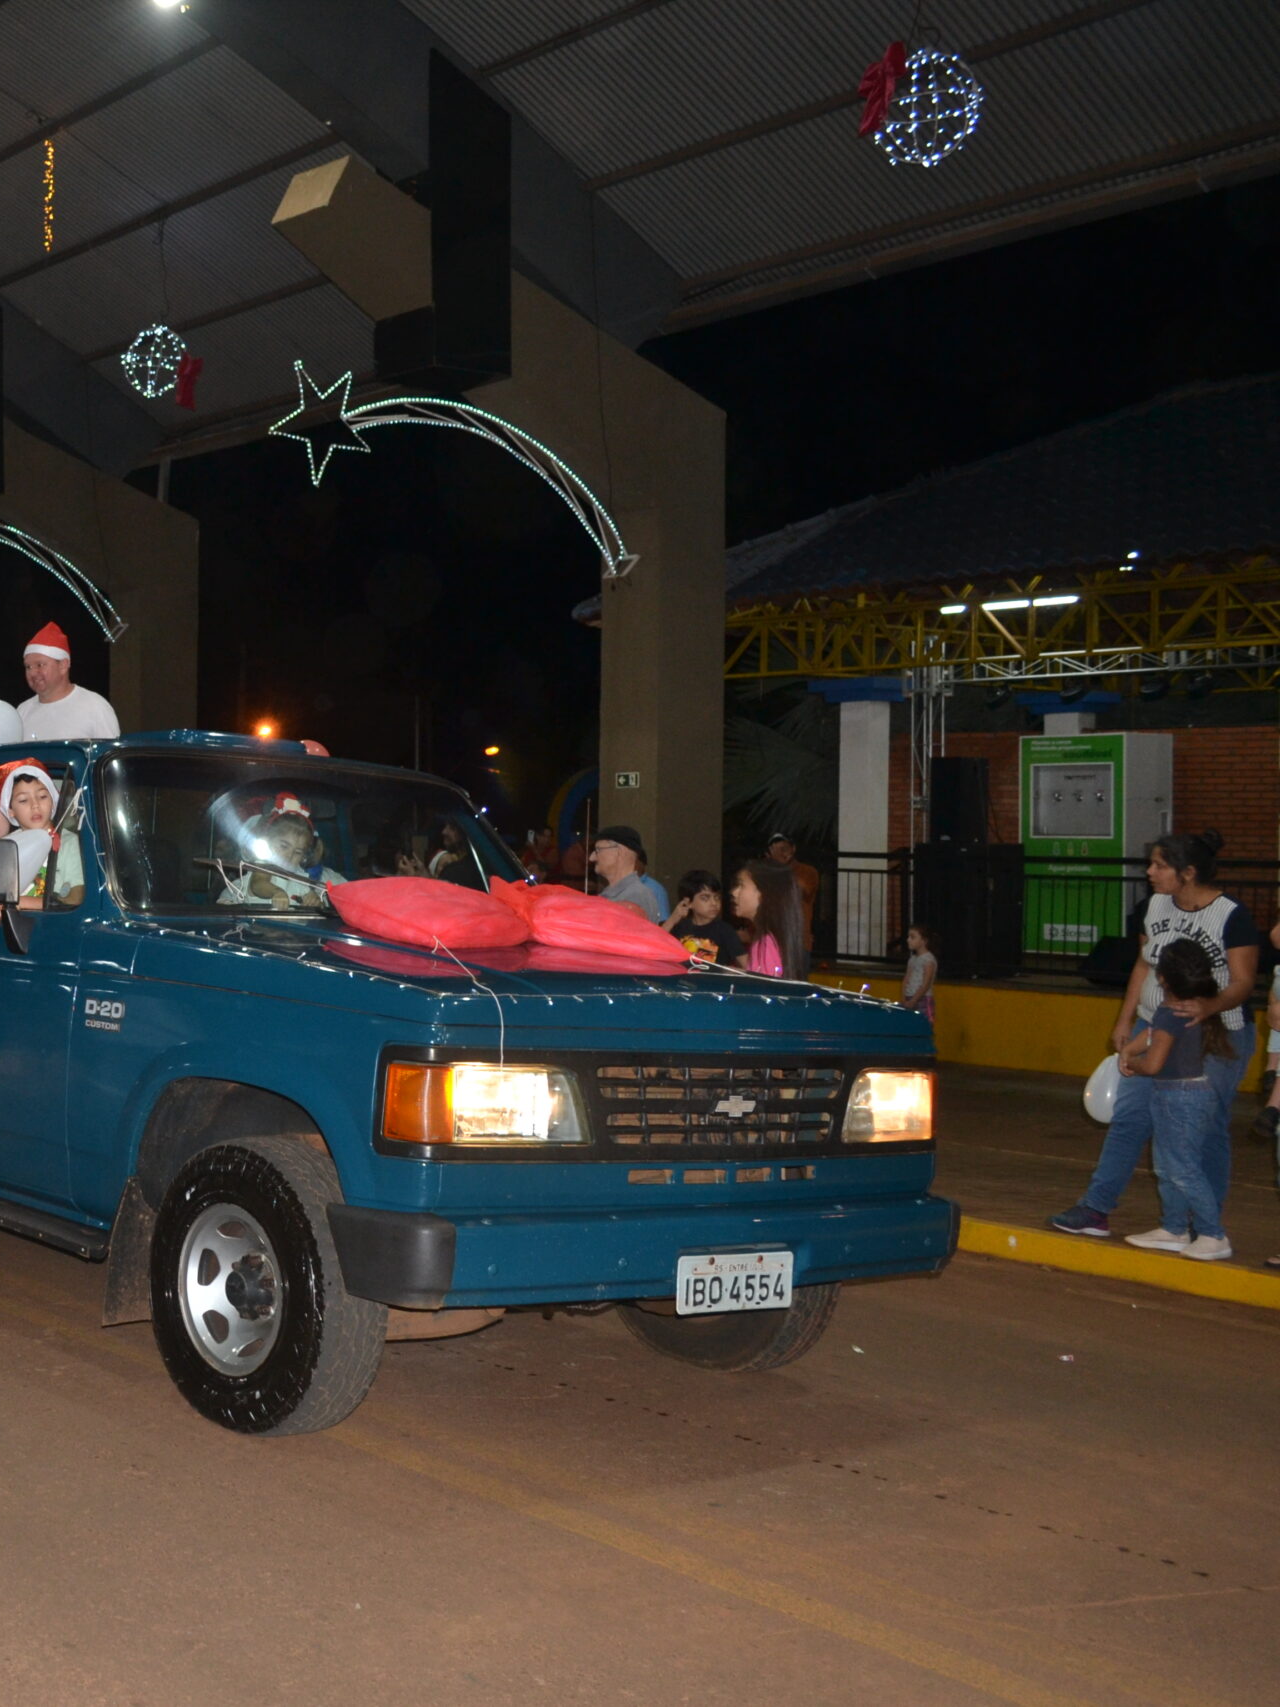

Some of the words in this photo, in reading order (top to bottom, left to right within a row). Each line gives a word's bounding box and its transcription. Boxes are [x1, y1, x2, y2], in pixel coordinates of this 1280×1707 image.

[1151, 918, 1170, 936] DE
[1174, 918, 1227, 968] JANEIRO
[84, 999, 123, 1018] D-20
[84, 1019, 120, 1031] CUSTOM
